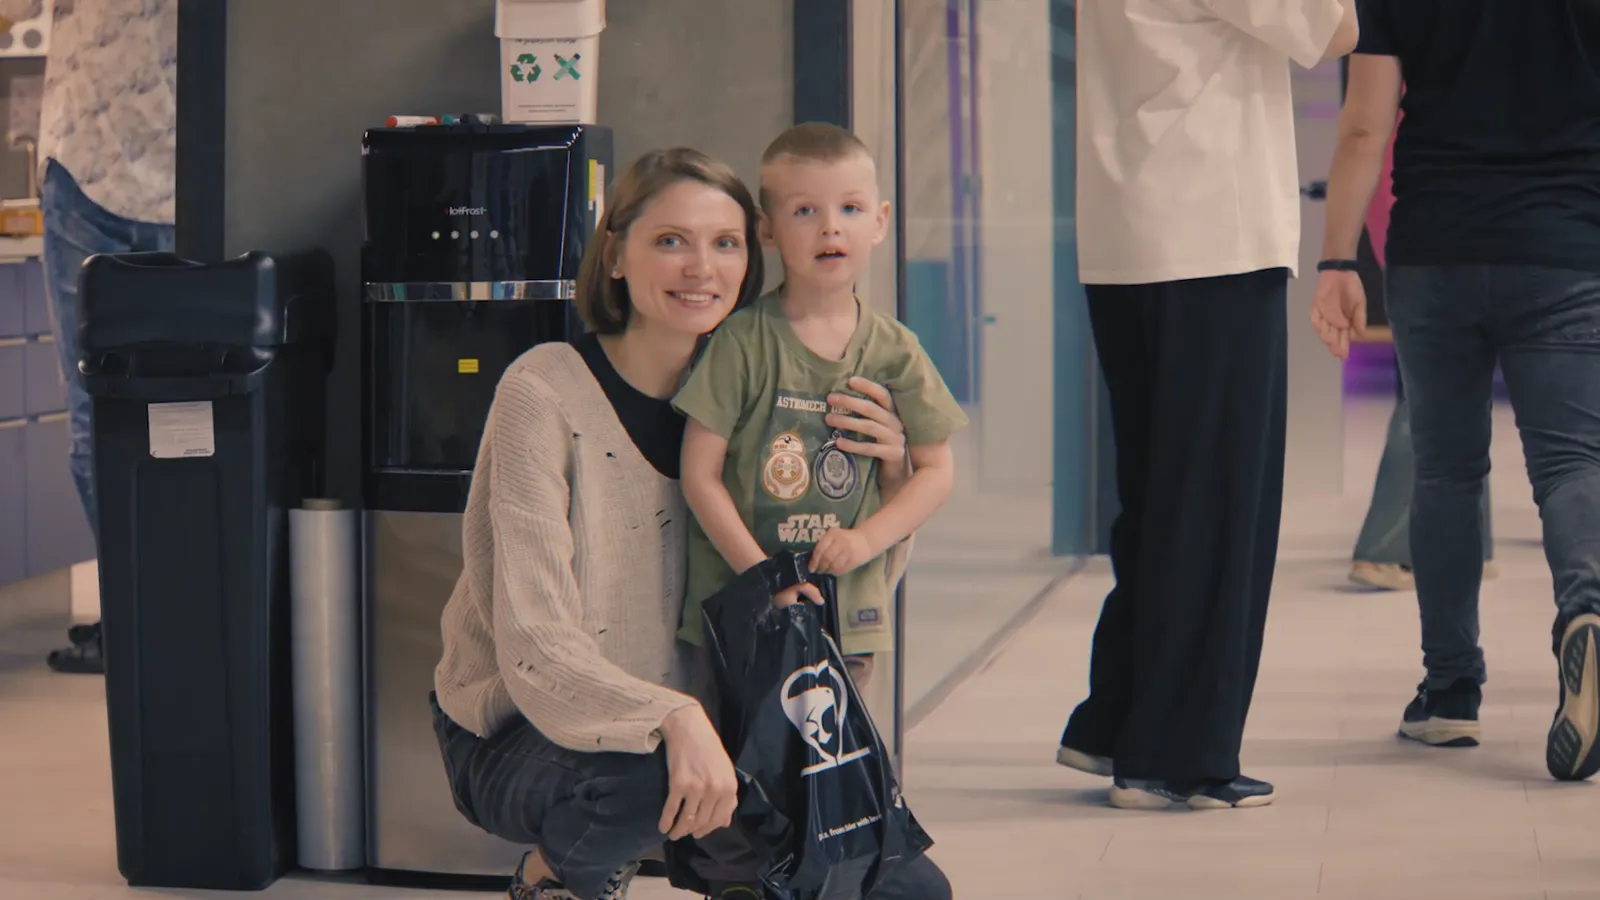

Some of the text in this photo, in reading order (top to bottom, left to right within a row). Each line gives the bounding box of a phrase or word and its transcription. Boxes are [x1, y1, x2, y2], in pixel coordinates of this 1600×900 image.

[776, 396, 827, 412] ASTROMECH
[778, 513, 840, 529] STAR
[778, 527, 827, 542] WAR
[829, 828, 845, 836] from
